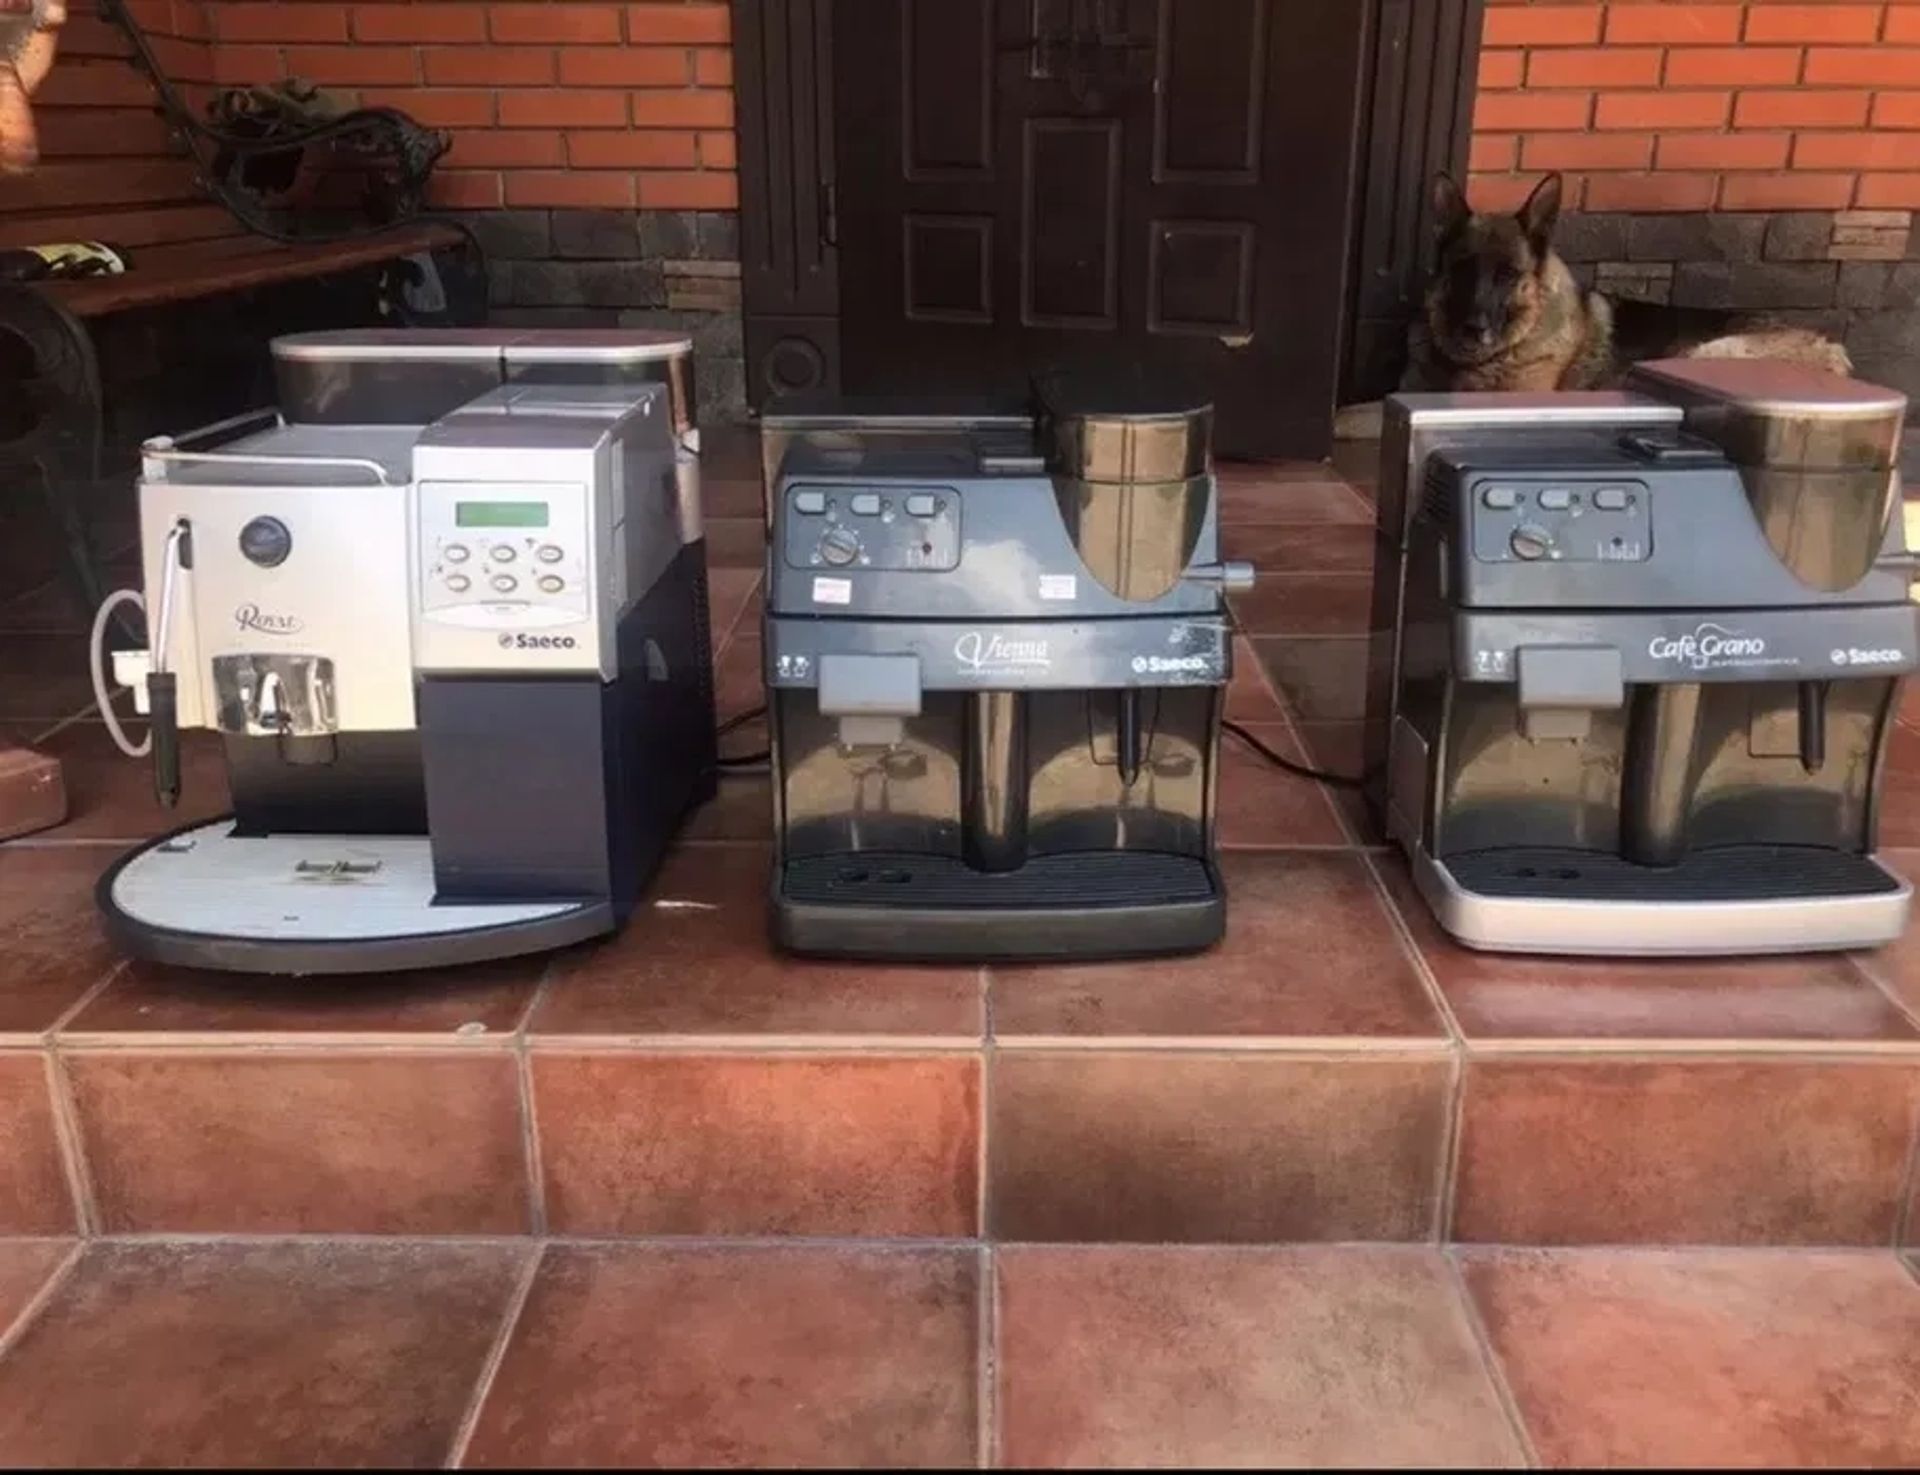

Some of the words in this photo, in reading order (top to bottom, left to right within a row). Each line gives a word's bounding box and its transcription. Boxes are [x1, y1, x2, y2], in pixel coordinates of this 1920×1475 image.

[516, 633, 575, 649] Saeco
[1699, 634, 1765, 657] Grano
[953, 631, 1052, 668] Vienna
[1848, 648, 1903, 664] Saeco
[1148, 656, 1205, 672] Saeco
